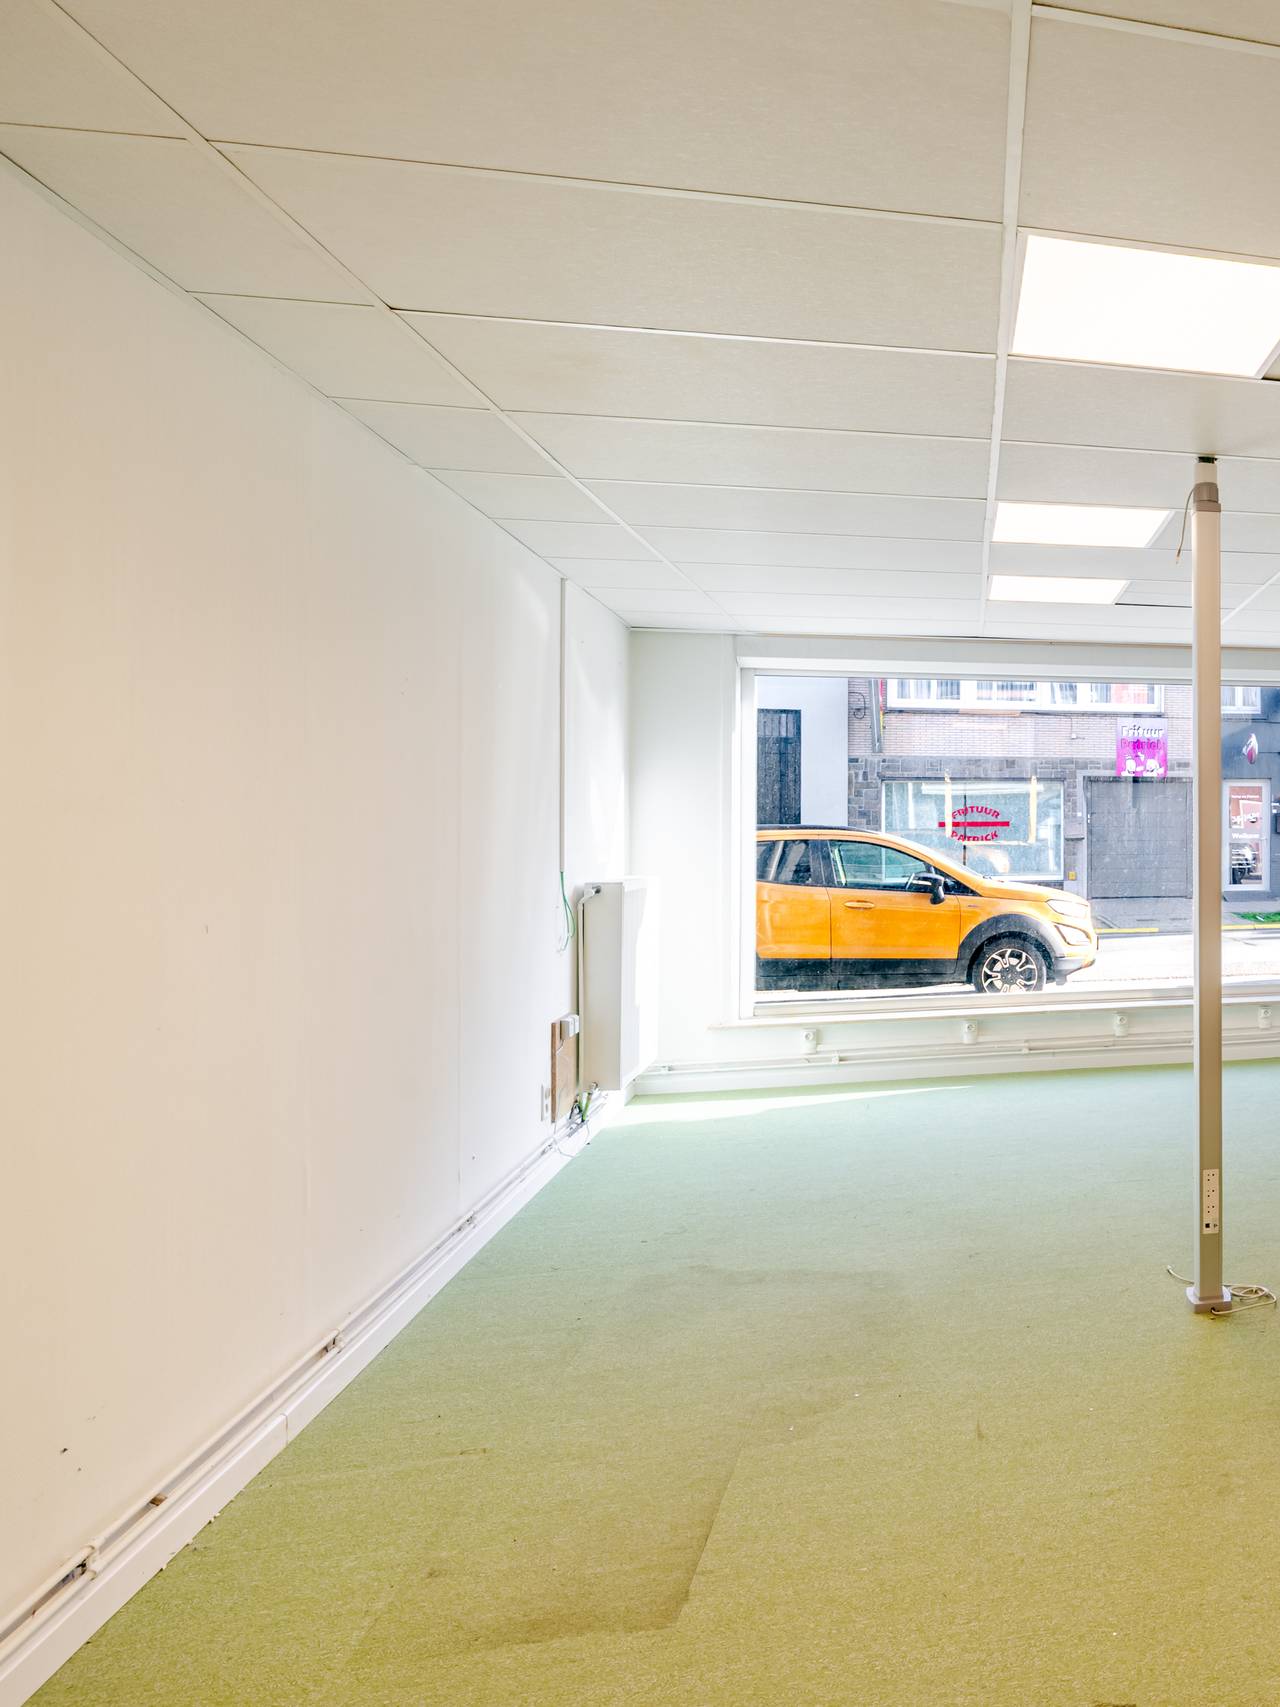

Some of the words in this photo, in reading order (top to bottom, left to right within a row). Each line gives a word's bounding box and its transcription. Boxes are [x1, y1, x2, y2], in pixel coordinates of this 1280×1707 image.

[1121, 724, 1163, 737] Frituur
[951, 805, 1000, 819] FRITUUR
[951, 829, 999, 842] PATRICK
